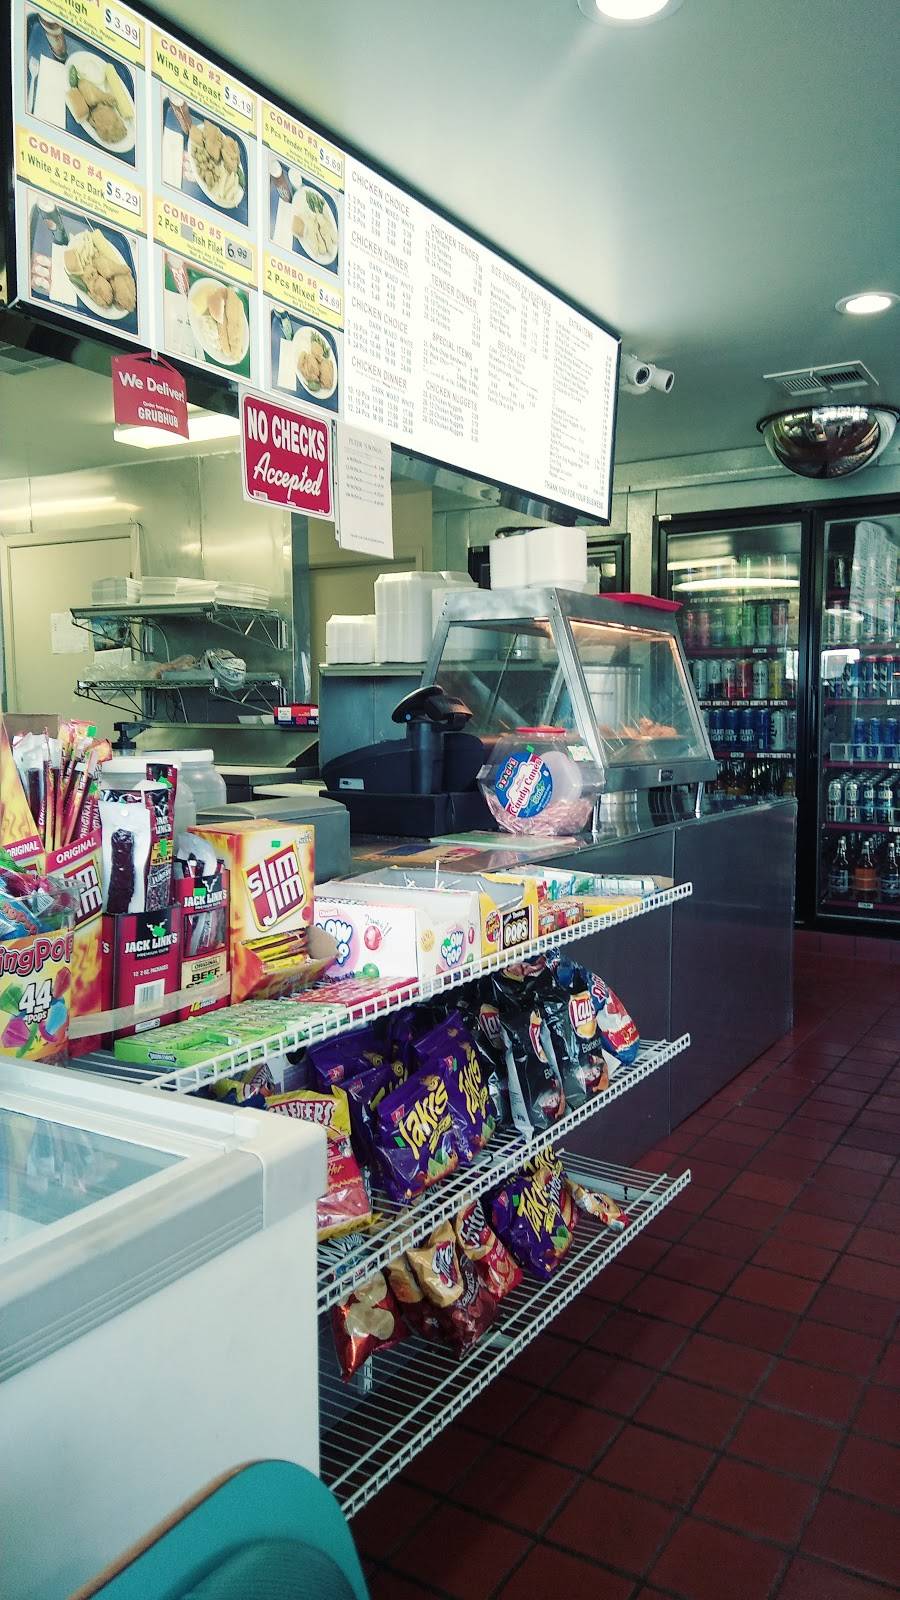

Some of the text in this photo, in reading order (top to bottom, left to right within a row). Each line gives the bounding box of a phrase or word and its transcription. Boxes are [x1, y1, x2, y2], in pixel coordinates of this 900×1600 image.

[156, 50, 179, 77] Wing
[183, 69, 189, 81] &
[192, 74, 221, 102] Breast
[160, 39, 221, 85] COMBO #2
[269, 111, 318, 149] COMBO #3
[282, 134, 303, 151] Tender
[27, 153, 52, 174] White
[54, 168, 61, 178] &
[63, 171, 69, 181] 2
[70, 174, 85, 190] Pcs
[87, 182, 105, 200] Dark
[28, 136, 103, 181] COMBO #4
[352, 170, 409, 217] CHICKEN CHOICE
[157, 215, 163, 227] 2
[165, 219, 179, 234] Pcs
[163, 203, 222, 240] COMBO #5
[352, 231, 382, 257] CHICKEN
[385, 250, 408, 272] DINNER
[431, 224, 456, 248] CHICKEN
[458, 242, 479, 263] TENDER
[267, 270, 315, 303] 2 Pcs Mixed
[270, 258, 318, 289] COMBO #6
[352, 296, 381, 320] CHICKEN
[384, 313, 408, 334] CHOICE
[433, 332, 472, 360] SPECIAL ITEMS
[118, 370, 186, 404] We Deliver!
[352, 356, 381, 377] CHICKEN
[384, 371, 407, 388] DINNER
[426, 380, 477, 411] CHICKEN NUGGETS
[137, 406, 179, 428] GRUBHUB
[247, 406, 325, 462] NO CHECKS
[253, 451, 323, 502] Accepted
[509, 758, 543, 814] Candy Canes
[56, 838, 97, 864] ORIGINAL
[184, 894, 206, 908] JACK
[124, 932, 178, 954] JACK LINK'S
[503, 917, 529, 947] POPS
[192, 967, 220, 982] BEEF
[18, 978, 52, 1014] 44
[399, 1081, 449, 1161] Takis
